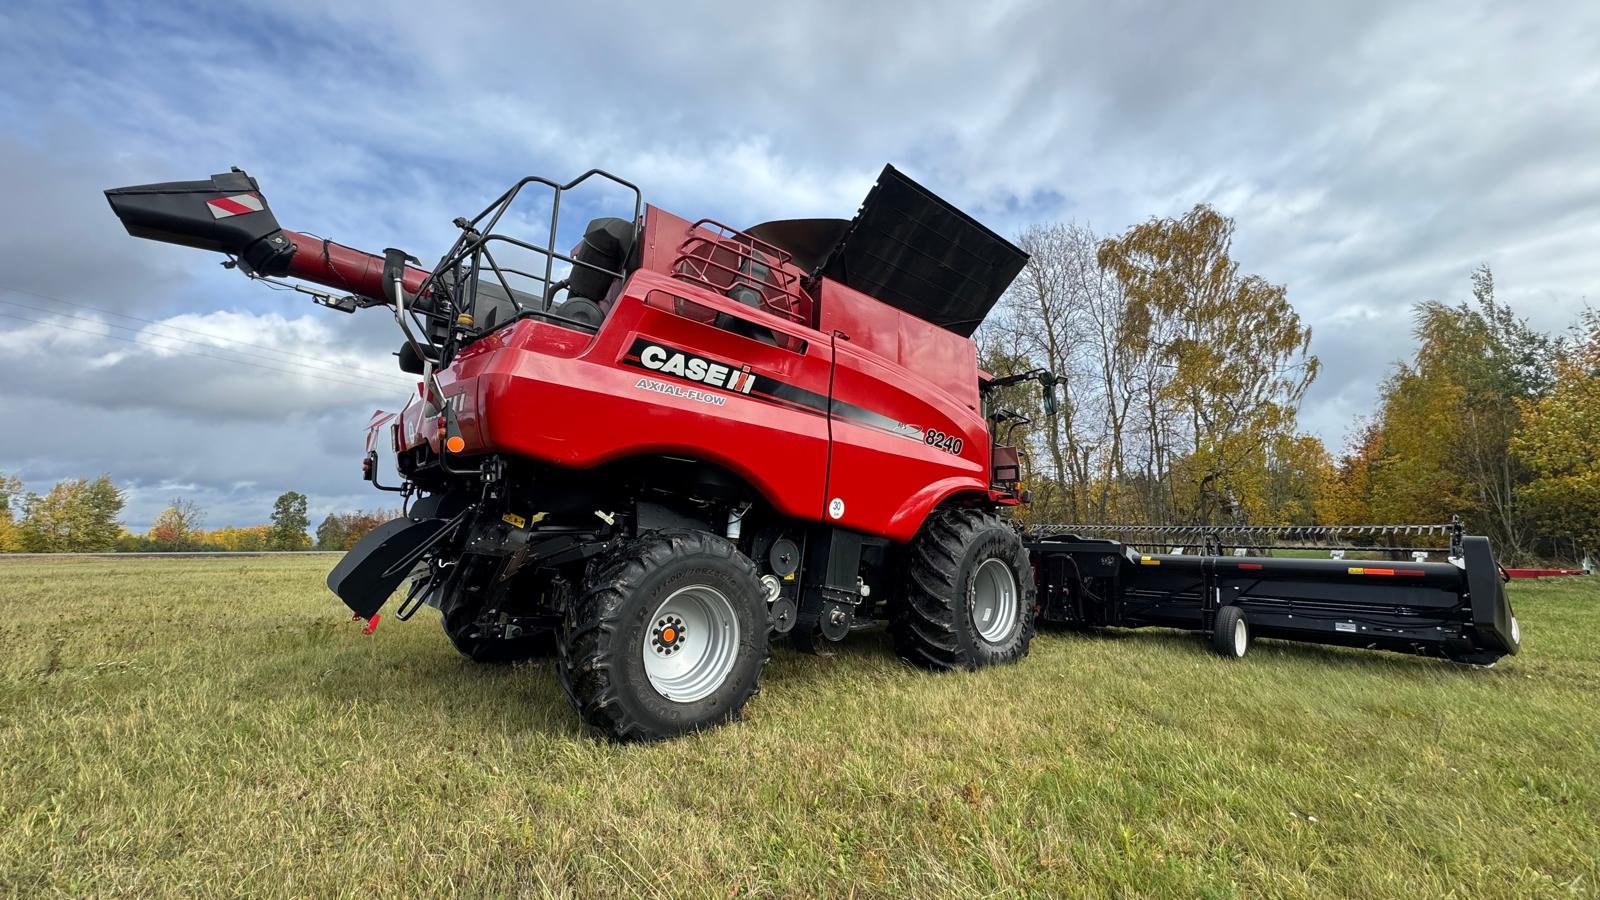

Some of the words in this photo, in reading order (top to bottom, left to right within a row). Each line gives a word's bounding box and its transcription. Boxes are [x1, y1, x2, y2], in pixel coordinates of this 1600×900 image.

[640, 345, 729, 386] CASE
[635, 378, 727, 406] AXIAL-FLOW
[925, 429, 963, 455] 8240
[832, 500, 842, 511] 30
